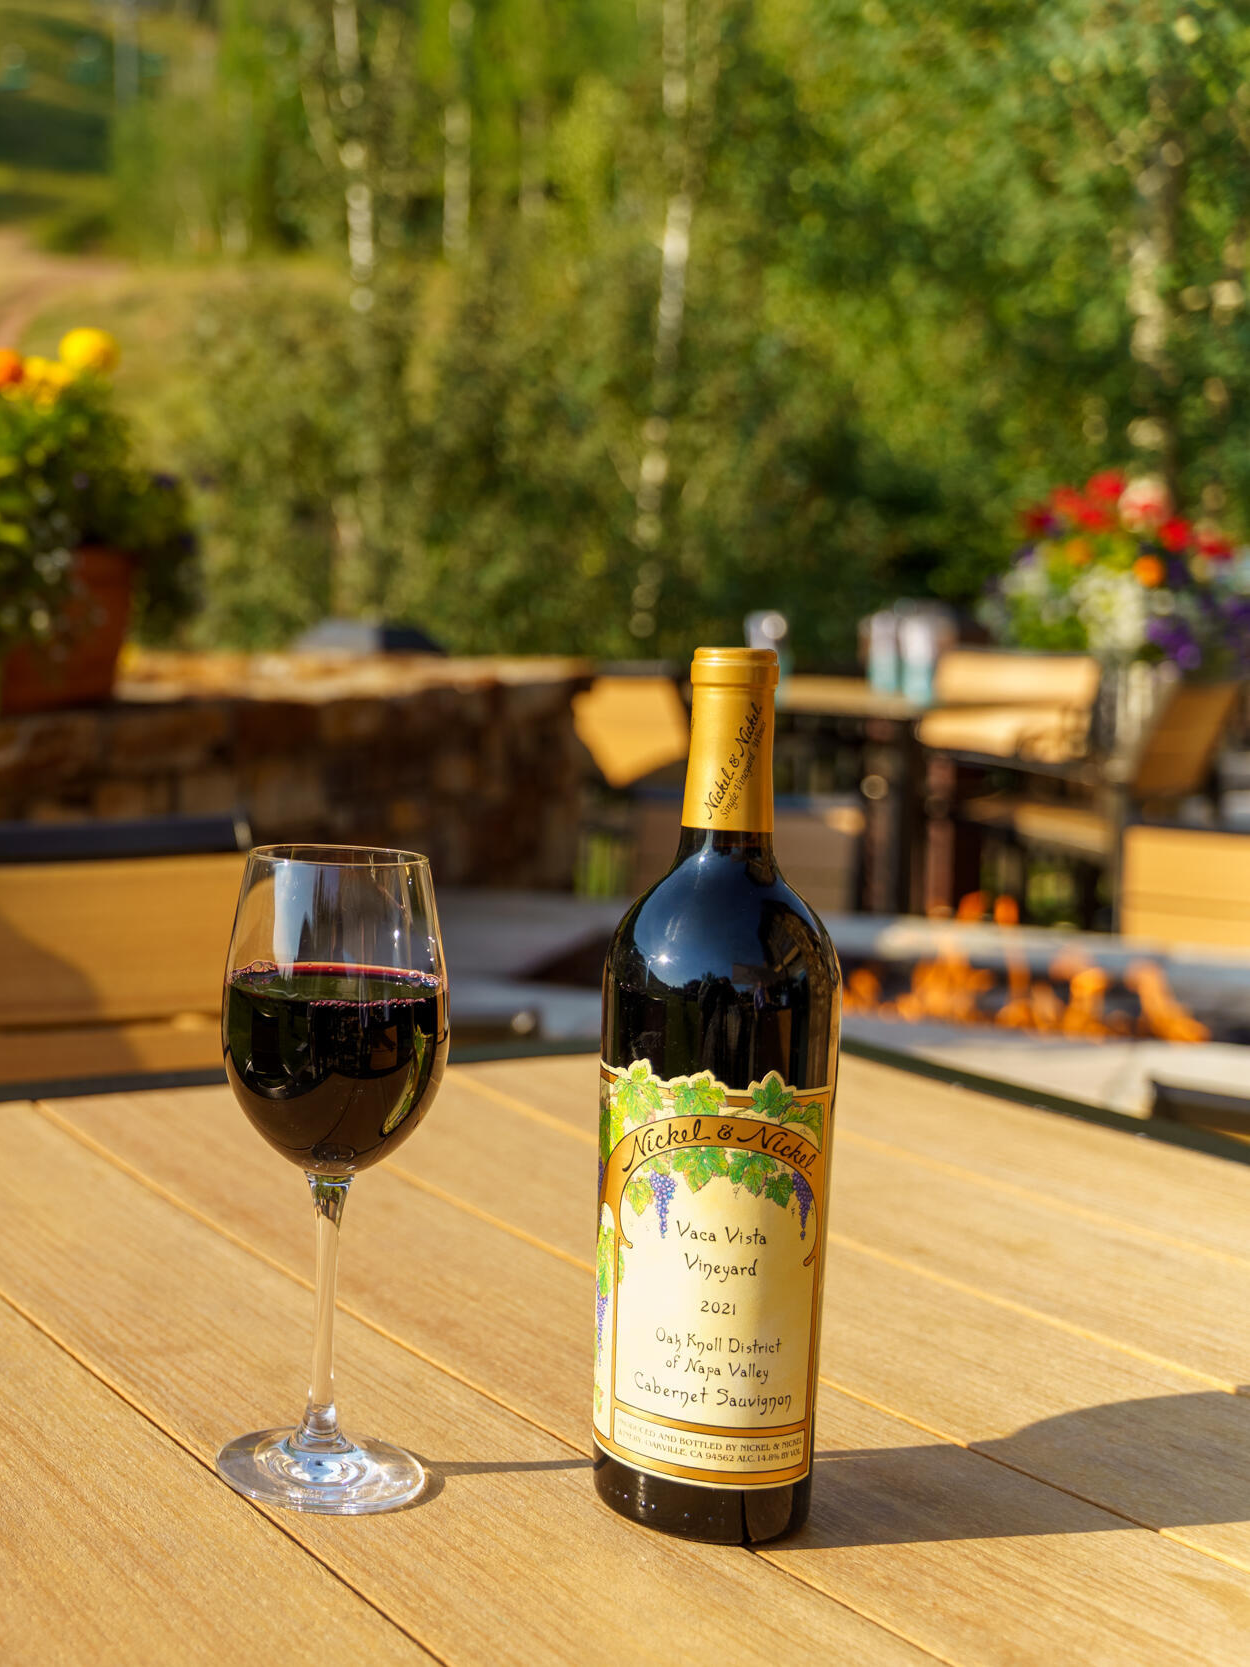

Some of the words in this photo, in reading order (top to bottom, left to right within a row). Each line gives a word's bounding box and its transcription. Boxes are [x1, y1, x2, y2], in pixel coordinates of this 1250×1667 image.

[703, 767, 735, 820] Nickel
[729, 753, 740, 768] &
[735, 702, 763, 758] Nickel
[720, 790, 739, 820] Single
[734, 753, 756, 792] Vineyard
[622, 1118, 711, 1173] Nickel
[717, 1124, 734, 1141] &
[737, 1126, 817, 1177] Nickel
[676, 1220, 717, 1242] Vaca
[725, 1226, 767, 1245] Vista
[684, 1252, 758, 1283] Vineyard
[700, 1300, 736, 1315] 2021
[655, 1327, 682, 1352] Oak
[686, 1332, 722, 1355] Knoll
[728, 1337, 782, 1354] District
[665, 1355, 680, 1369] of
[684, 1357, 721, 1381] Napa
[728, 1362, 769, 1385] Valley
[634, 1371, 708, 1408] Cabernet
[716, 1388, 791, 1415] Sauvignon
[658, 1432, 677, 1443] AND
[679, 1437, 723, 1450] BOTTLED
[725, 1443, 737, 1452] BY
[740, 1443, 770, 1451] NICKEL
[773, 1442, 780, 1450] &
[689, 1450, 703, 1459] CA
[705, 1453, 735, 1462] 94562
